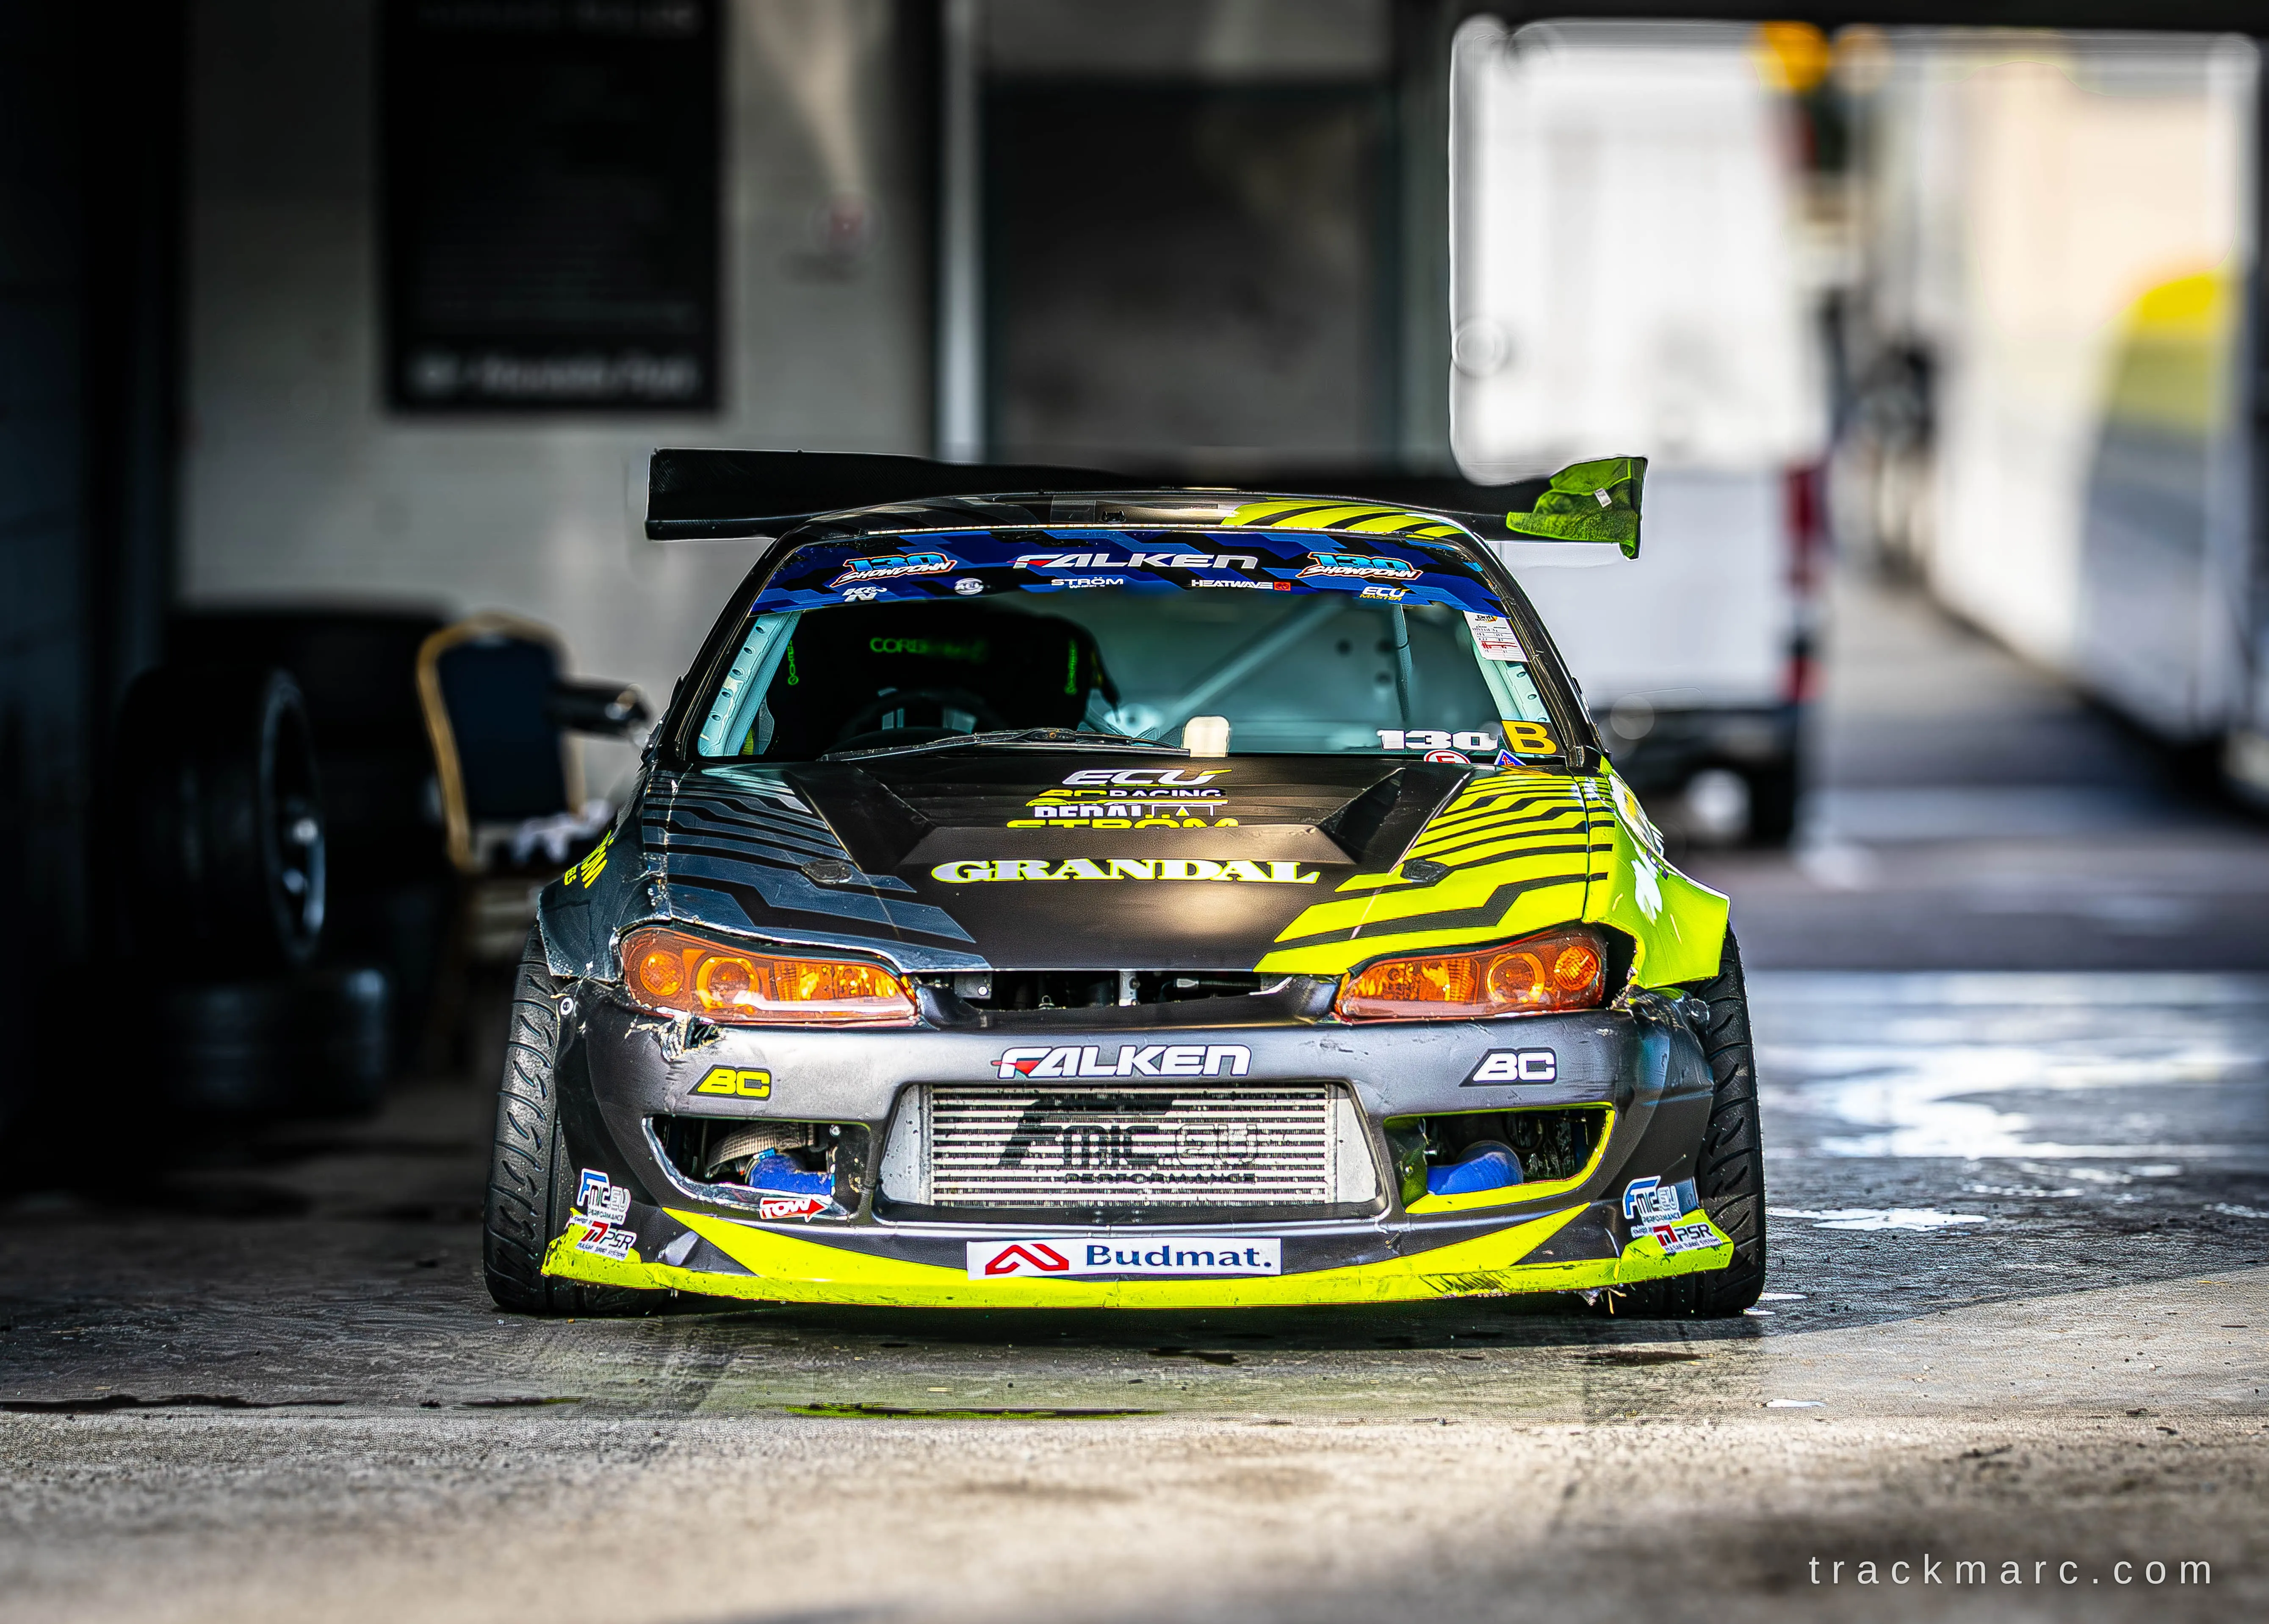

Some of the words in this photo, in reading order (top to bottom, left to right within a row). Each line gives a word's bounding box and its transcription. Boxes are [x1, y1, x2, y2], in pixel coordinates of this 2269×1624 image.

[849, 554, 944, 572] 130
[1008, 553, 1258, 569] FALKEN
[1313, 554, 1410, 571] 130
[837, 562, 951, 583] SHOWDOWN
[1303, 565, 1417, 578] SHOWDOWN
[1051, 577, 1123, 586] STRÖM
[1191, 579, 1273, 589] HEATWAVE
[841, 587, 887, 601] K&N
[1361, 586, 1409, 597] ECU
[1377, 729, 1498, 751] 130
[1501, 720, 1557, 754] B
[1062, 769, 1232, 786] ECU
[931, 858, 1320, 883] GRANDAL
[993, 1045, 1251, 1078] FALKEN
[1472, 1052, 1555, 1082] BC
[697, 1069, 770, 1098] BC
[762, 1200, 810, 1219] TOW
[1085, 1245, 1272, 1268] Budmat.
